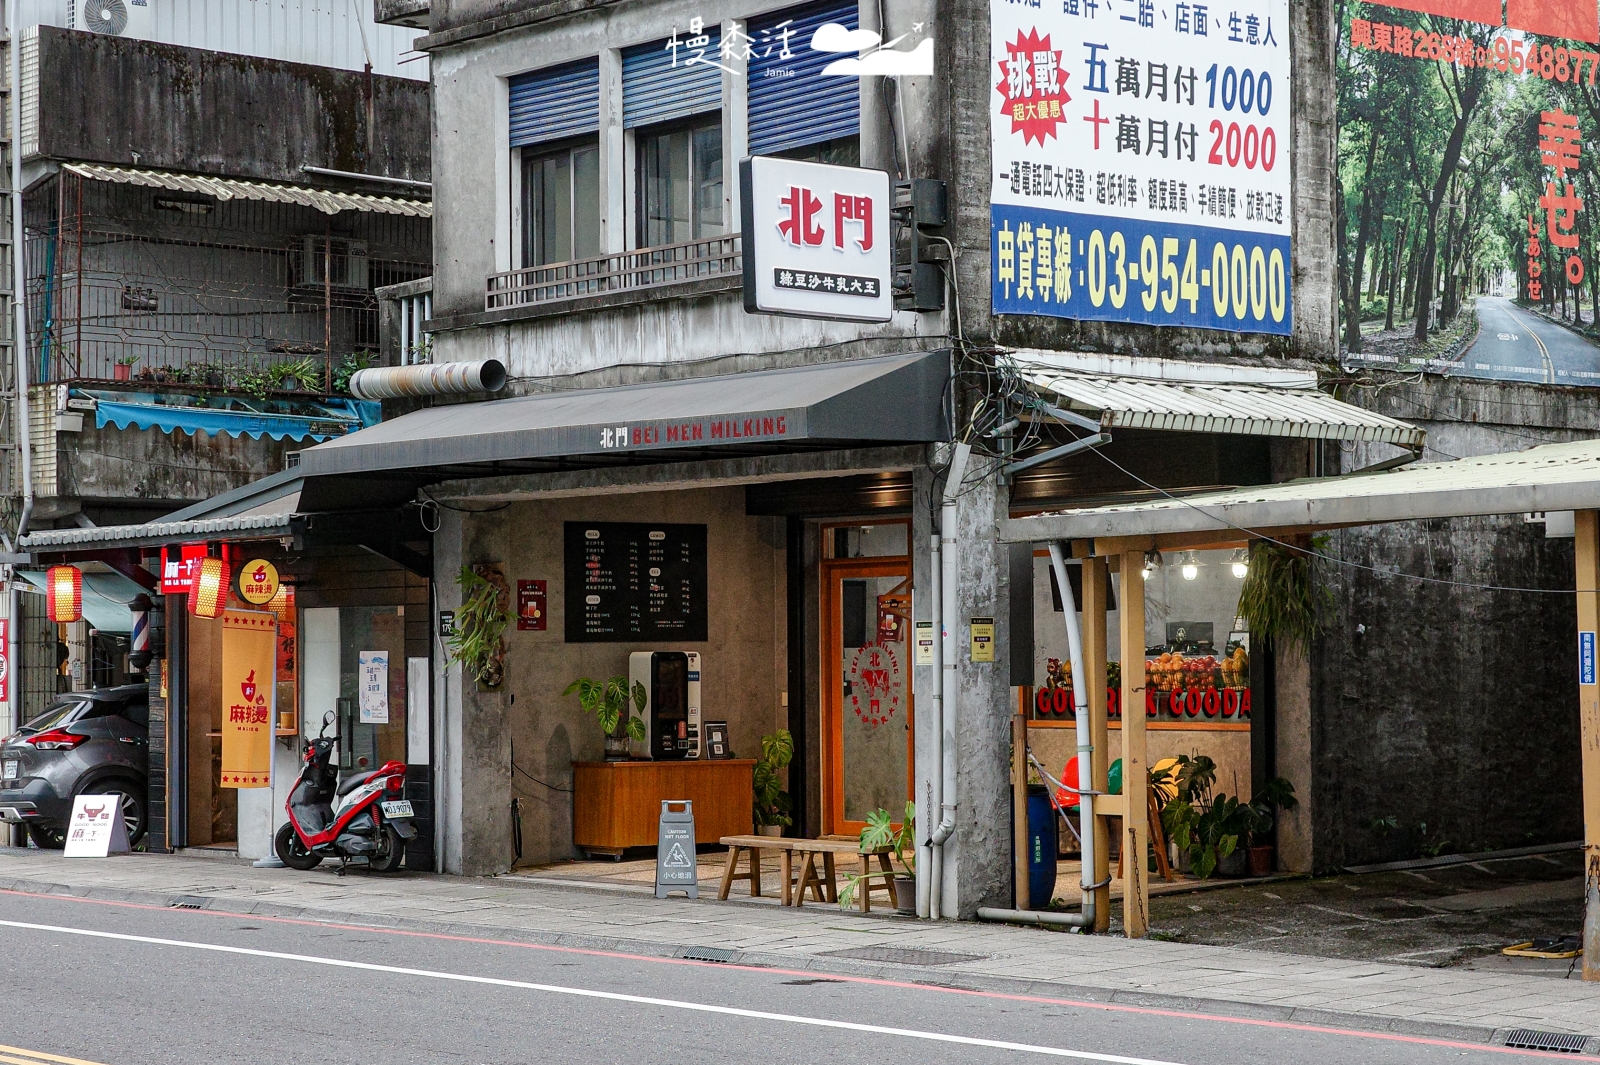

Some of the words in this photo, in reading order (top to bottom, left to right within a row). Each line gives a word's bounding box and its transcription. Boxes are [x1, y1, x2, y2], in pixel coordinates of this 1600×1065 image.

[1351, 18, 1475, 68] 興東路268號
[1006, 50, 1061, 99] 挑戰
[1013, 100, 1061, 121] 超大優惠
[777, 185, 873, 252] 北門
[1528, 214, 1542, 300] しあわせ
[779, 271, 876, 294] 綠豆沙牛乳大王
[600, 427, 628, 448] 北門
[632, 427, 659, 445] BEI
[667, 422, 703, 442] MEN
[711, 416, 787, 439] MILKING
[246, 584, 272, 595] 麻辣燙
[1584, 634, 1592, 682] 南無阿彌陀佛
[664, 872, 692, 880] 小心地滑
